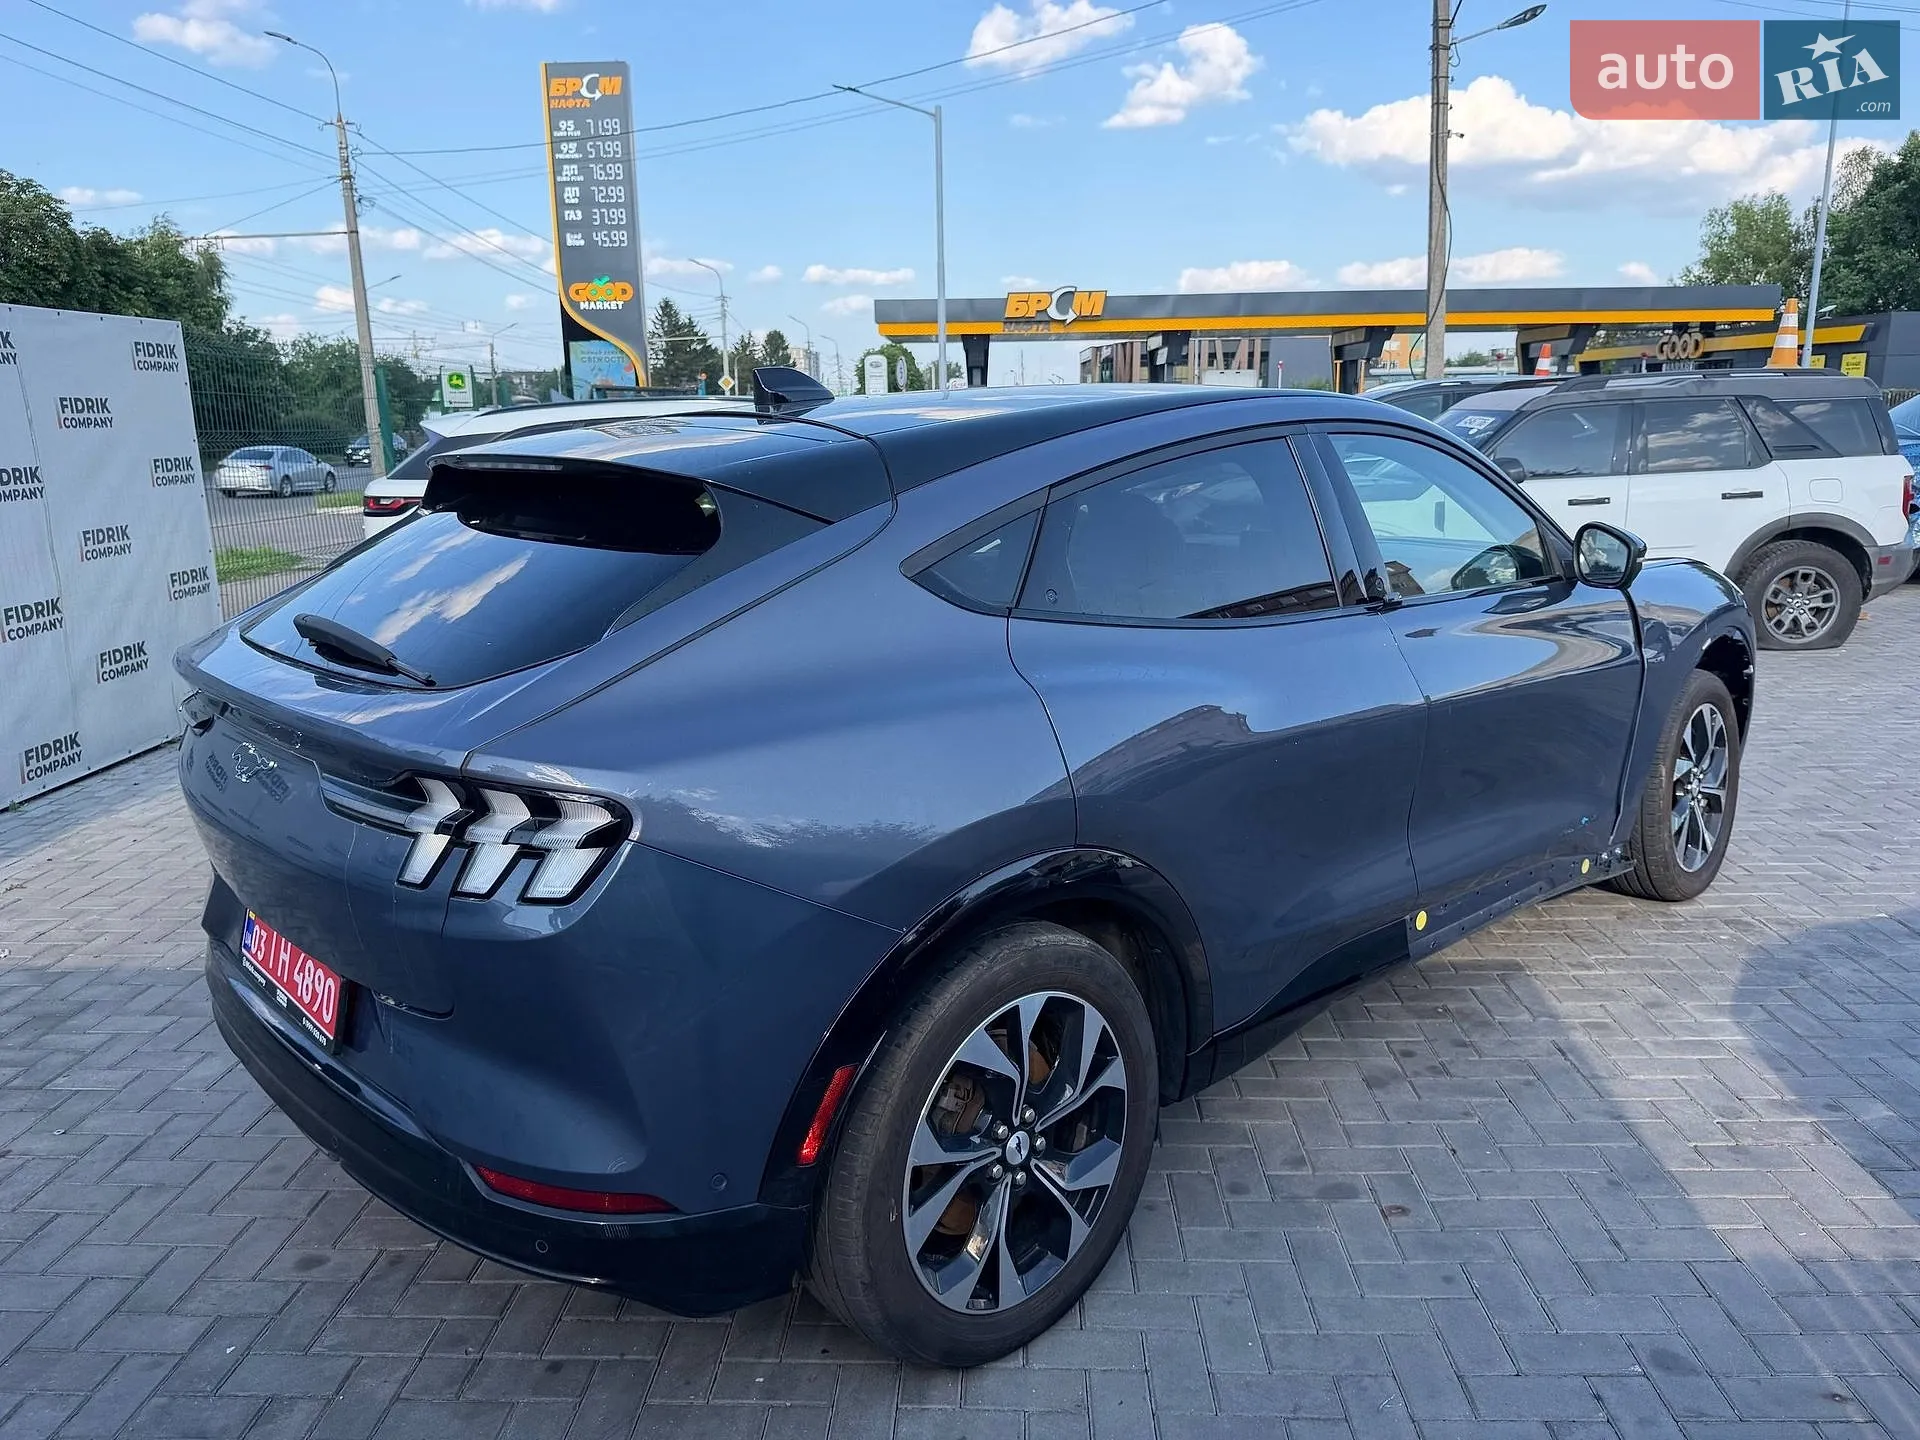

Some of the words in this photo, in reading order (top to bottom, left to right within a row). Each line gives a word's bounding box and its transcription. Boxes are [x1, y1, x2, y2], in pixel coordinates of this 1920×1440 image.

[558, 119, 576, 131] 95
[585, 118, 620, 136] 71.99
[560, 141, 578, 154] 95
[586, 141, 622, 158] 57.99
[562, 164, 579, 177] ДП
[589, 163, 624, 180] 76.99
[563, 186, 580, 199] ДП
[590, 186, 625, 203] 72.99
[564, 209, 583, 221] ГАЗ
[592, 208, 627, 225] 37.99
[592, 230, 628, 247] 45.99
[568, 281, 634, 302] GOOD
[580, 300, 625, 310] MARKET
[1004, 285, 1107, 327] БРСМ
[133, 341, 178, 359] FIDRIK
[1656, 332, 1705, 360] GOOD
[137, 359, 180, 373] COMPANY
[59, 397, 112, 414] FIDRIK
[62, 416, 113, 429] COMPANY
[152, 456, 194, 474] FIDRIK
[155, 473, 195, 487] COMPANY
[0, 487, 44, 502] MPANY
[82, 524, 131, 547] FIDRIK
[85, 542, 132, 561] COMPANY
[170, 566, 209, 588] FIDRIK
[172, 582, 211, 601] COMPANY
[4, 597, 63, 626] FIDRIK
[7, 617, 64, 642] COMPANY
[99, 640, 148, 669] FIDRIK
[101, 658, 150, 682] COMPANY
[24, 732, 81, 767] FIDRIK
[26, 750, 83, 782] COMPANY
[250, 924, 268, 962] 03
[293, 952, 336, 1024] 4890
